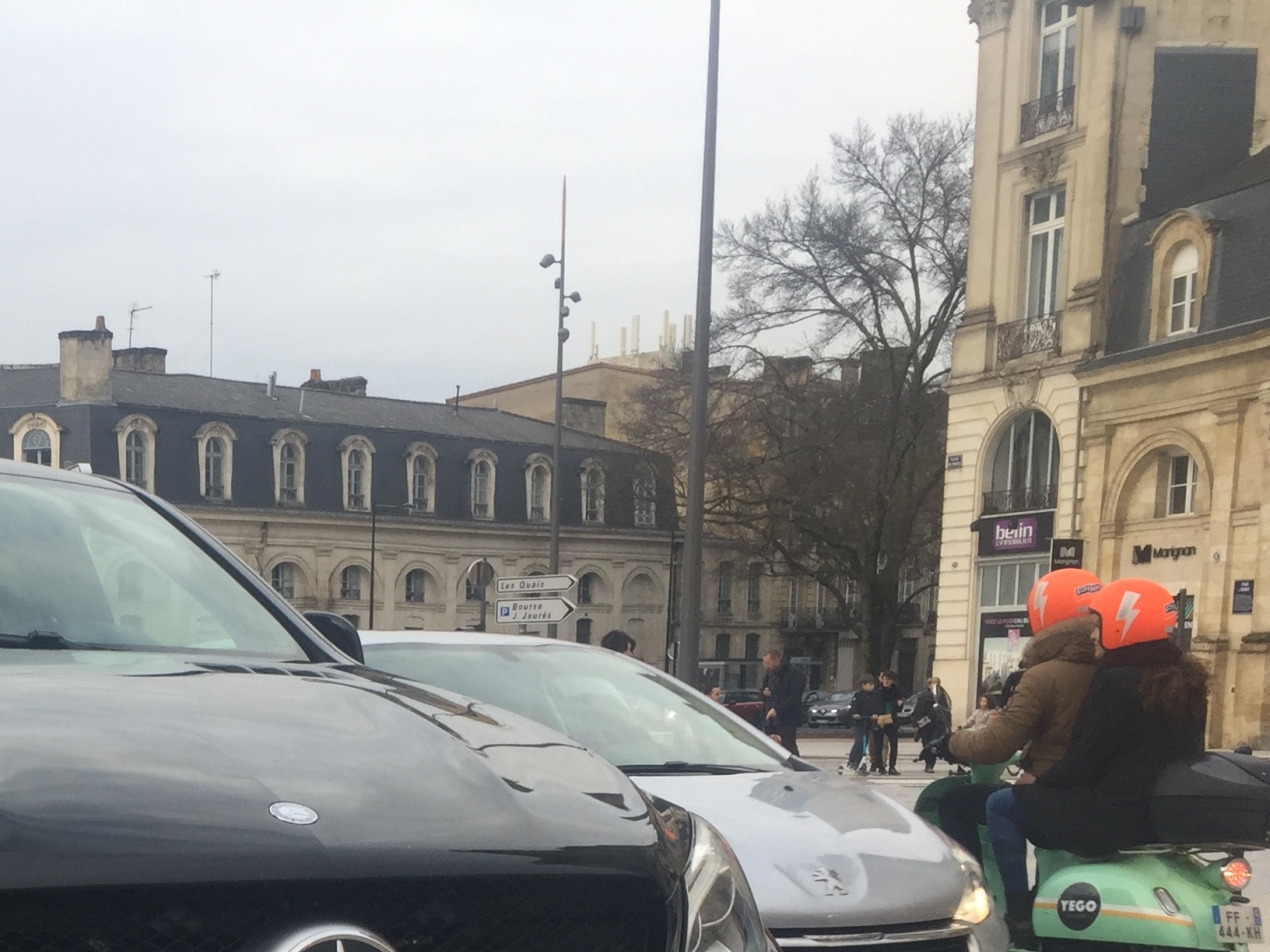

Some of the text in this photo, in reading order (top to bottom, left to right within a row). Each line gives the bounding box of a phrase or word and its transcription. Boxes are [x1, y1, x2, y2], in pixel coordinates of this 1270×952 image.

[1153, 546, 1196, 561] Marignan
[1054, 558, 1080, 566] Marignan
[500, 580, 545, 590] Les Quais
[512, 602, 543, 611] Bourse
[1061, 899, 1097, 912] YEGO
